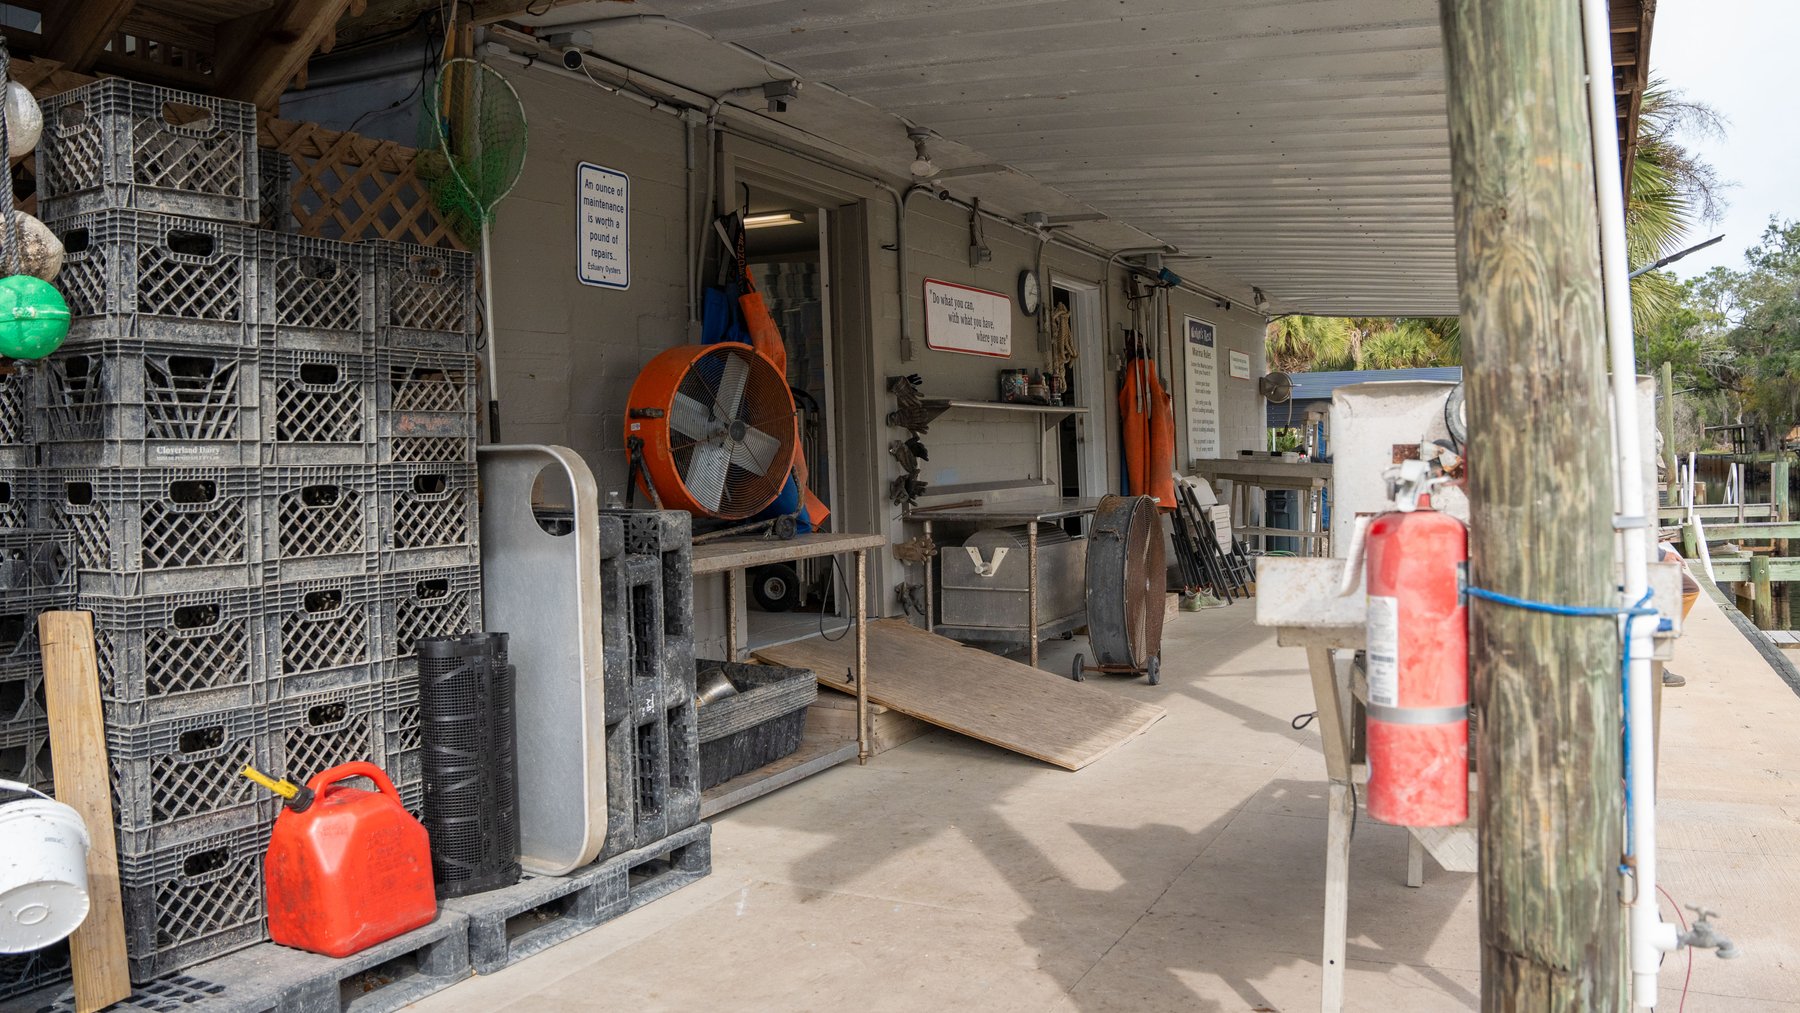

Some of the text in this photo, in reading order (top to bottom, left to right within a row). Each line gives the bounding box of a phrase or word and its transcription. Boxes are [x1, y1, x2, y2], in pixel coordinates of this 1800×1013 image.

[584, 179, 624, 197] An ounce of
[583, 196, 625, 214] maintenance
[587, 212, 620, 229] is worth a
[589, 231, 619, 245] pound of
[587, 262, 621, 275] Estuary Oysters
[940, 294, 954, 307] what
[954, 299, 964, 310] you
[964, 300, 975, 312] can,
[948, 312, 995, 330] with what you have,
[976, 331, 990, 343] where
[990, 335, 999, 346] you
[156, 446, 220, 455] Cloverland Dairy
